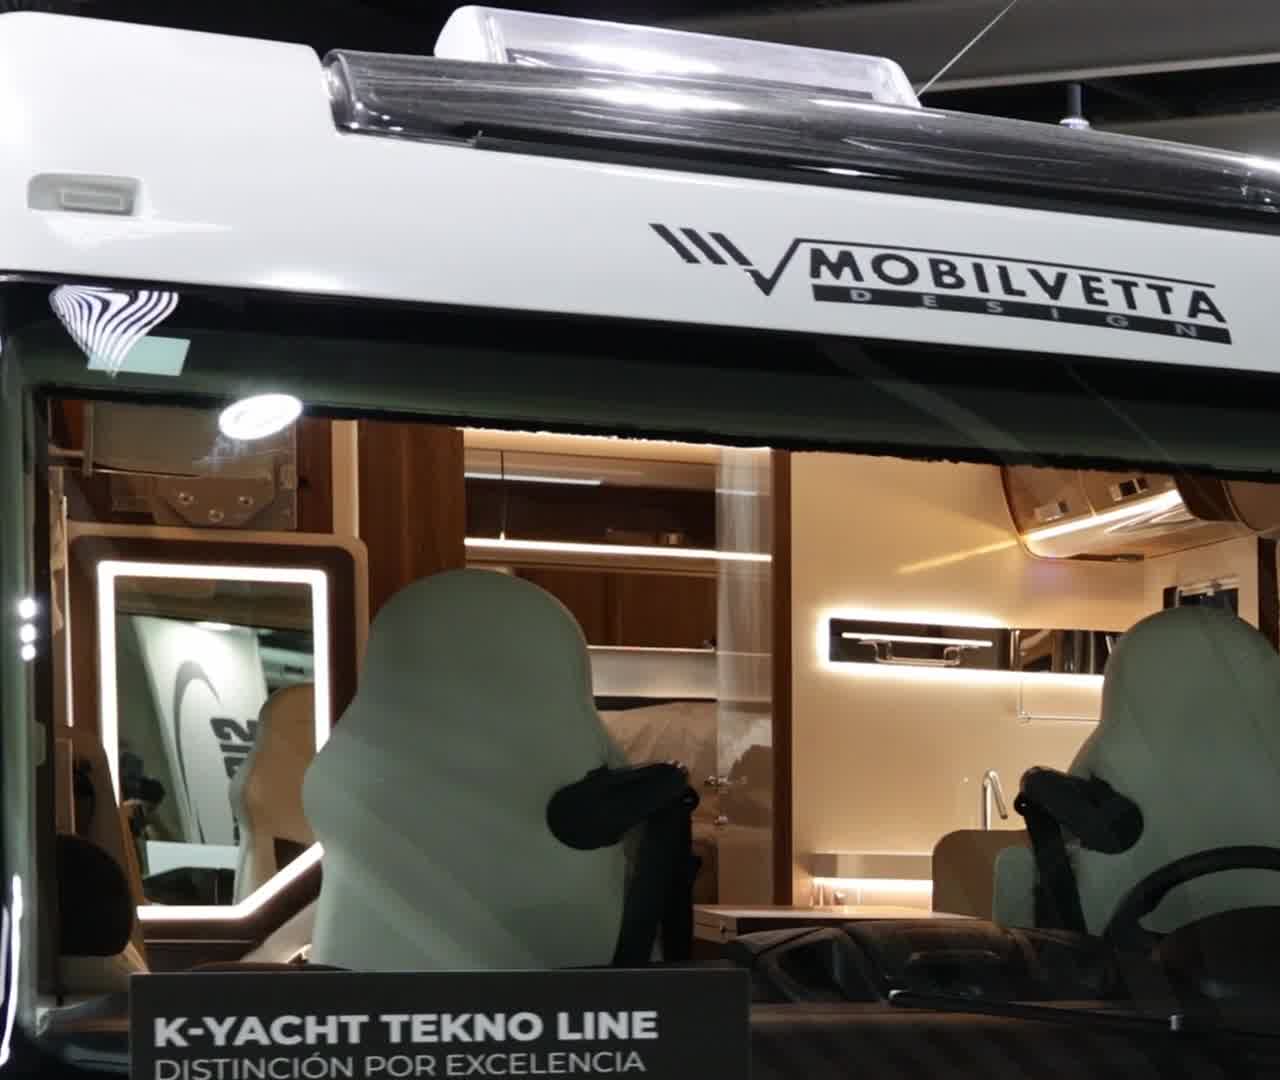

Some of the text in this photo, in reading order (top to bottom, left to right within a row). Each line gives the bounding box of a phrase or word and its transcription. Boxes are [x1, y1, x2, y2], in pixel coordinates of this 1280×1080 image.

[809, 248, 1227, 324] MOBILVETTA
[850, 290, 1199, 337] DESIGN
[153, 1010, 658, 1047] K-YACHT TEKNO LINE
[365, 1055, 435, 1078] POR
[446, 1052, 646, 1077] EXCELENCIA
